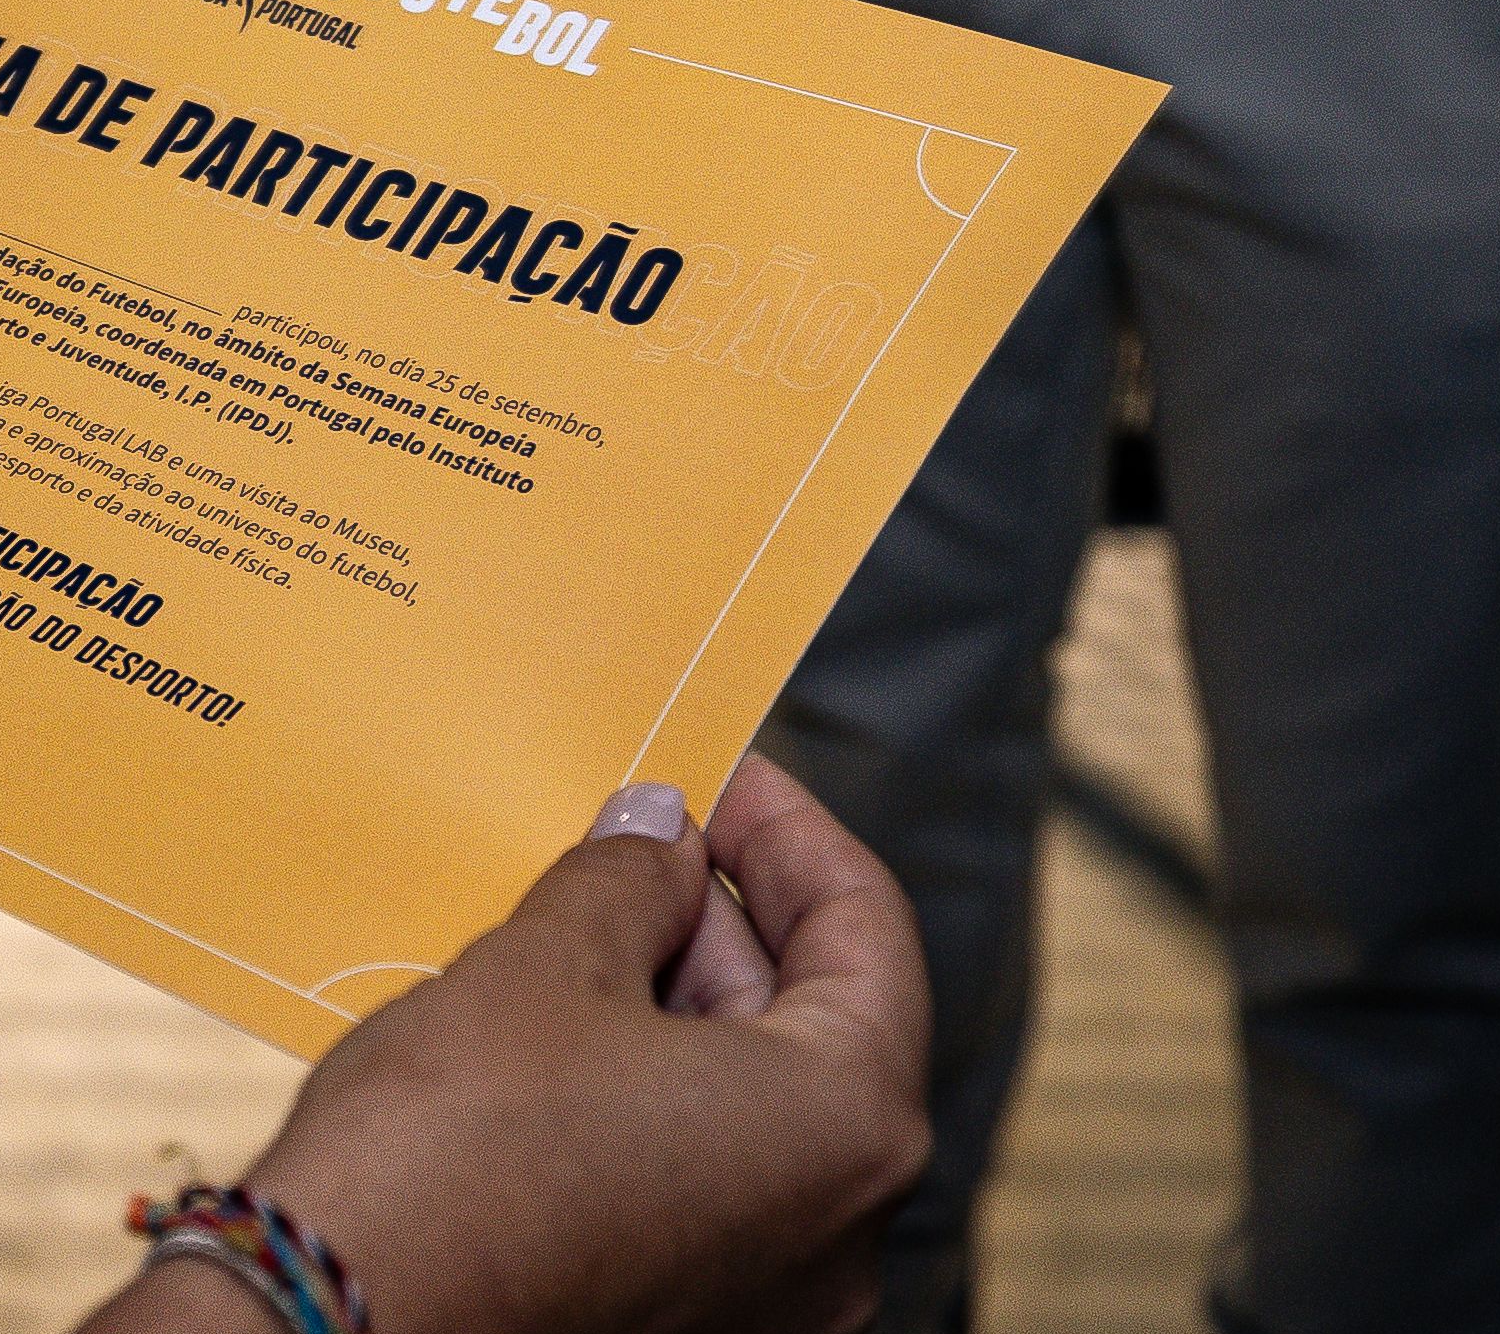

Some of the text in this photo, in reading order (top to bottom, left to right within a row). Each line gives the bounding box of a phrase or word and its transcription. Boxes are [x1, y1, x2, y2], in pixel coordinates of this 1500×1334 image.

[33, 63, 157, 153] DE
[139, 99, 685, 326] PARTICIPAÇÃO
[30, 332, 47, 347] e
[47, 337, 170, 400] Juventude,
[175, 384, 212, 413] I.P.
[216, 400, 293, 445] (IPDJ).
[55, 271, 86, 293] do
[87, 282, 177, 332] Futebol,
[181, 320, 214, 341] no
[213, 327, 297, 372] âmbito
[298, 361, 330, 385] da
[330, 371, 427, 420] Semana
[428, 405, 537, 458] Europeia
[95, 323, 228, 383] coordenada
[228, 373, 267, 397] em
[267, 383, 375, 437] Portugal
[368, 426, 426, 456] pelo
[427, 442, 535, 494] Instituto
[231, 305, 349, 361] participou,
[354, 348, 387, 370] no
[388, 357, 426, 383] dia
[426, 369, 460, 394] 25
[458, 381, 490, 406] de
[490, 394, 605, 449] setembro,
[7, 425, 25, 439] e
[23, 431, 165, 497] aproximação
[164, 490, 196, 510] ao
[196, 502, 294, 551] universo
[294, 541, 328, 565] do
[329, 552, 419, 607] futebol,
[28, 395, 126, 446] Portugal
[121, 433, 169, 463] LAB
[167, 455, 185, 471] e
[184, 462, 237, 492] uma
[239, 483, 299, 518] visita
[299, 509, 332, 530] ao
[332, 517, 410, 567] Museu,
[76, 488, 93, 503] e
[93, 493, 125, 516] da
[124, 508, 230, 561] atividade
[230, 547, 291, 590] física.
[29, 614, 83, 652] DO
[73, 635, 246, 728] DESPORTO!
